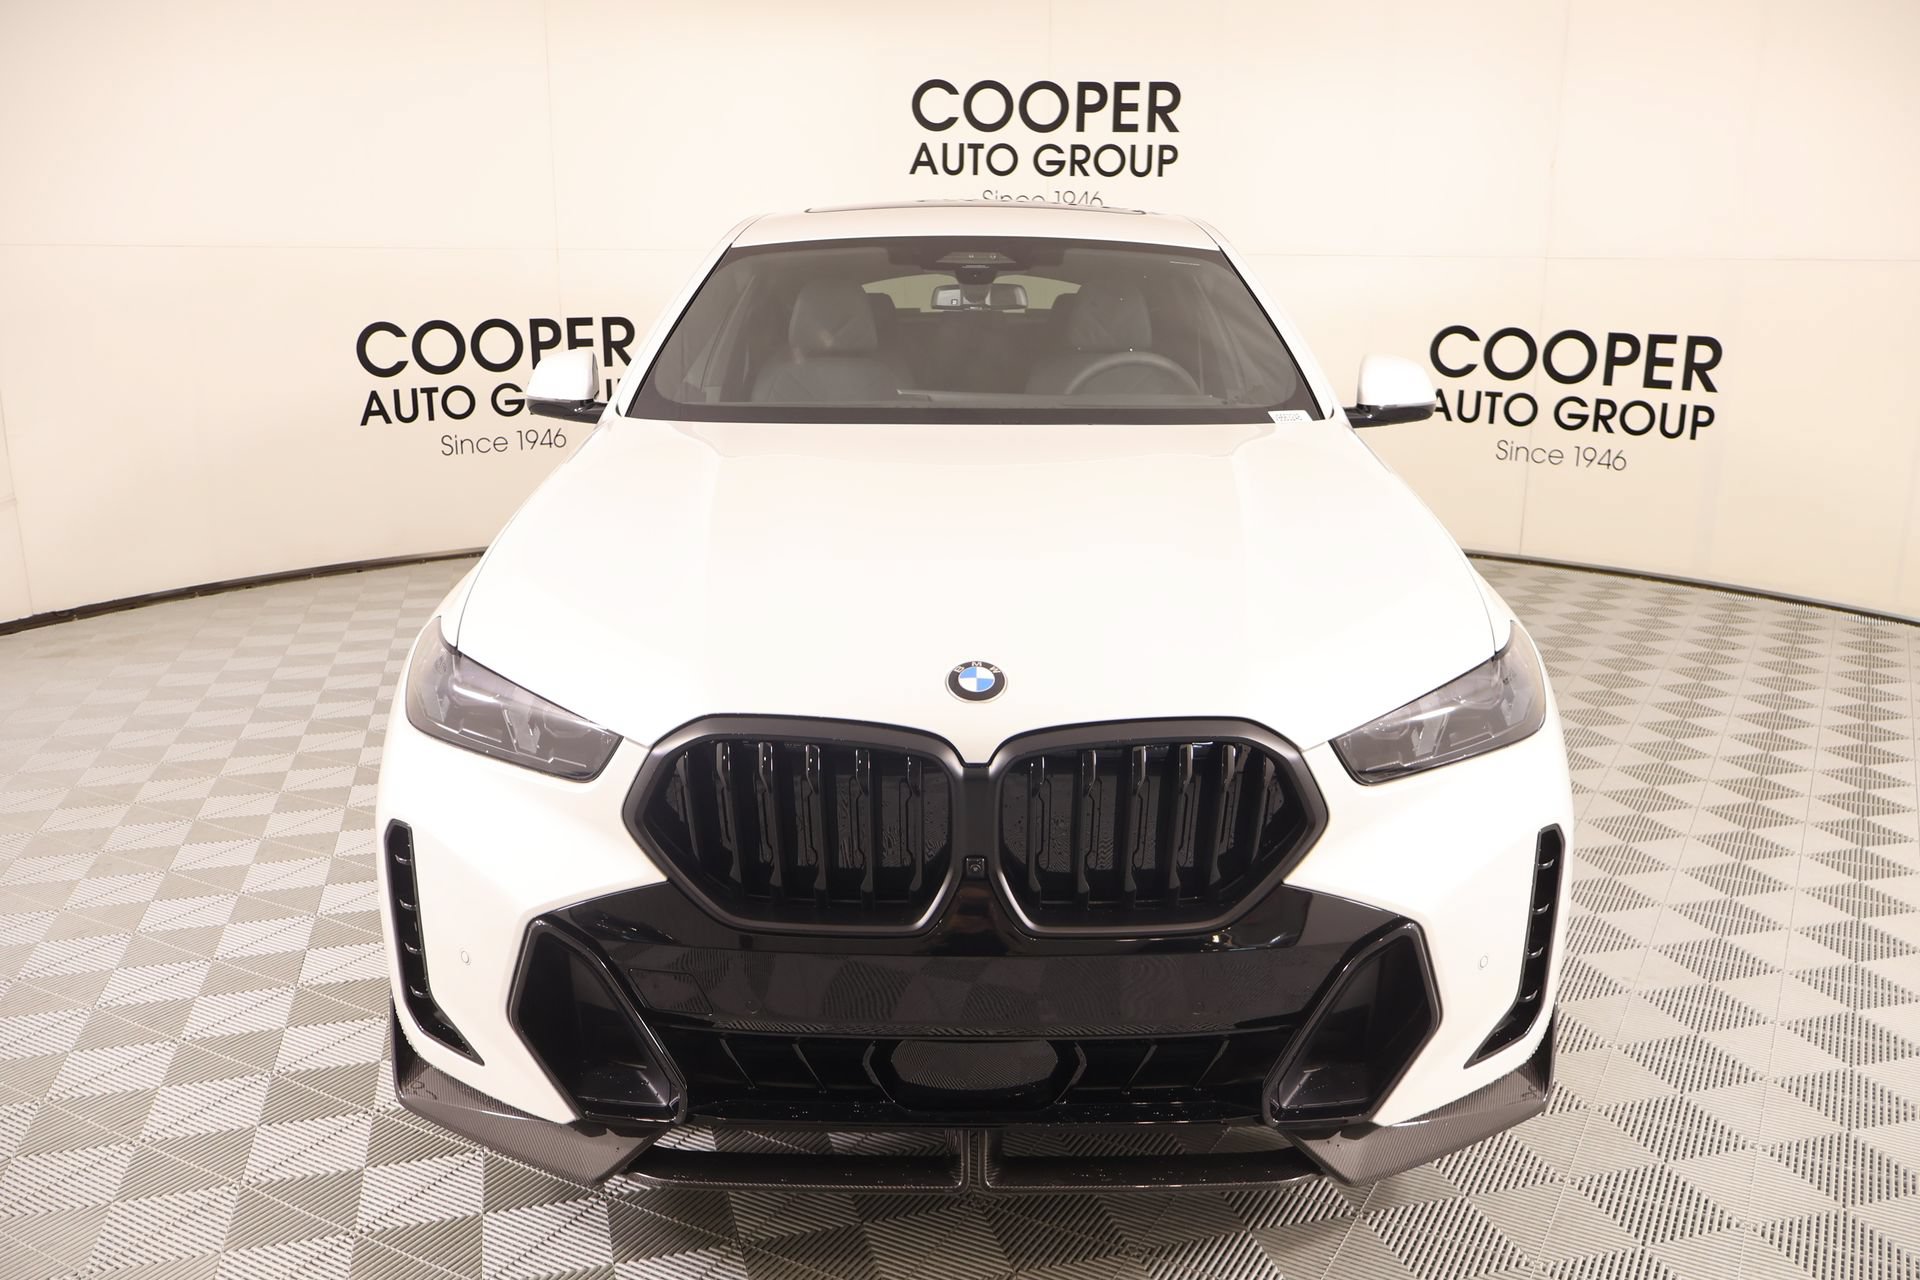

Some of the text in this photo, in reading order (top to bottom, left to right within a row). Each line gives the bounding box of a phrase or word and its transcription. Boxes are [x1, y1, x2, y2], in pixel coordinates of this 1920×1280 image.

[911, 79, 1181, 133] COOPER
[909, 143, 1178, 177] AUTO GROUP
[356, 317, 635, 378] COOPER
[1430, 325, 1723, 393] COOPER
[360, 385, 476, 426] AUTO
[1434, 389, 1715, 440] AUTO GROUP
[441, 428, 567, 456] Since 1946
[1495, 439, 1627, 471] Since 1946
[953, 661, 1001, 673] BMW
